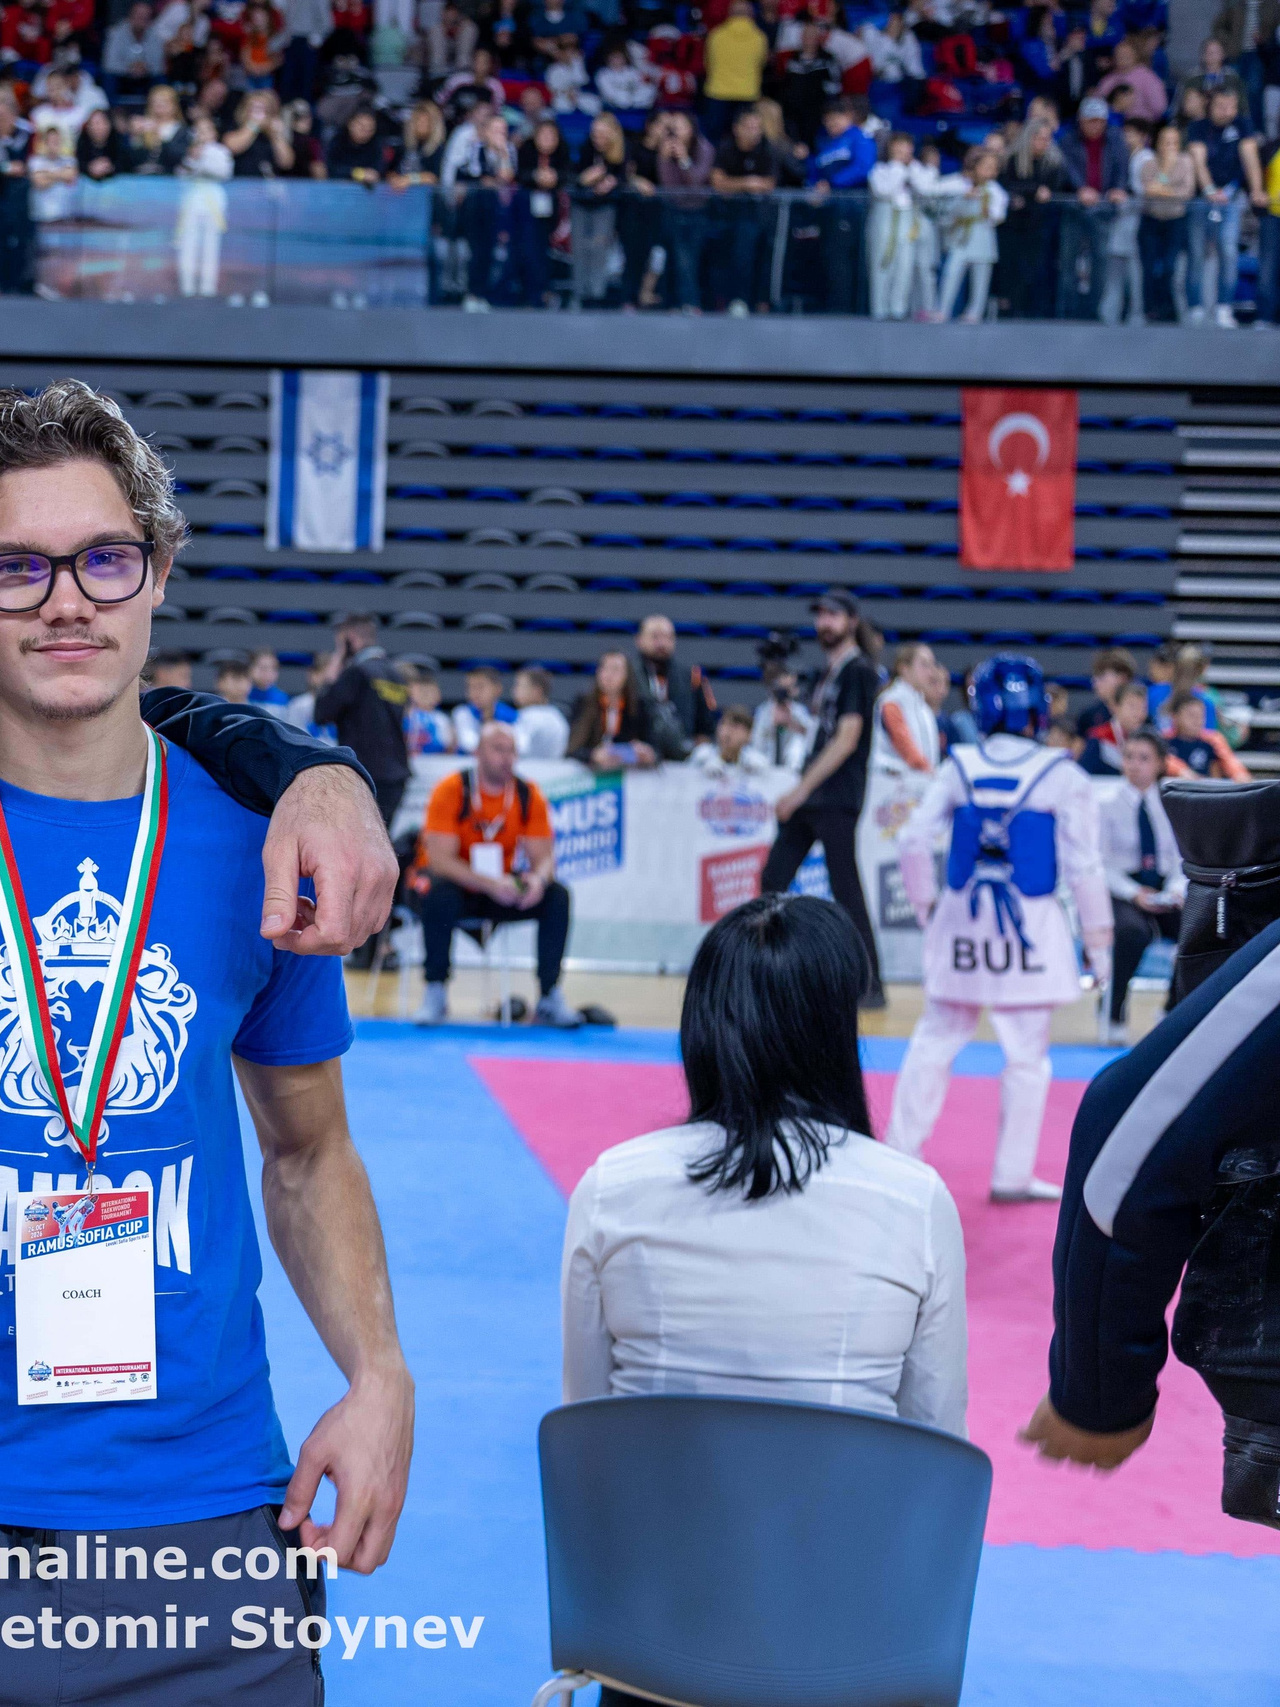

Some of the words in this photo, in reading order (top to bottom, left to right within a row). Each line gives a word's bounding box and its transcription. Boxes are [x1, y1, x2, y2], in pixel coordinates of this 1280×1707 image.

[953, 936, 1047, 975] BUL
[101, 1195, 137, 1209] INTERNATIONAL
[101, 1203, 131, 1215] TAEKWONDO
[101, 1208, 133, 1221] TOURNAMENT
[27, 1235, 74, 1257] RAMUS
[77, 1226, 115, 1246] SOFIA
[117, 1220, 143, 1236] CUP
[62, 1288, 102, 1300] COACH
[55, 1366, 91, 1375] INTERNATIONAL
[91, 1365, 119, 1373] TAEKWONDO
[119, 1363, 149, 1371] TOURNAMENT
